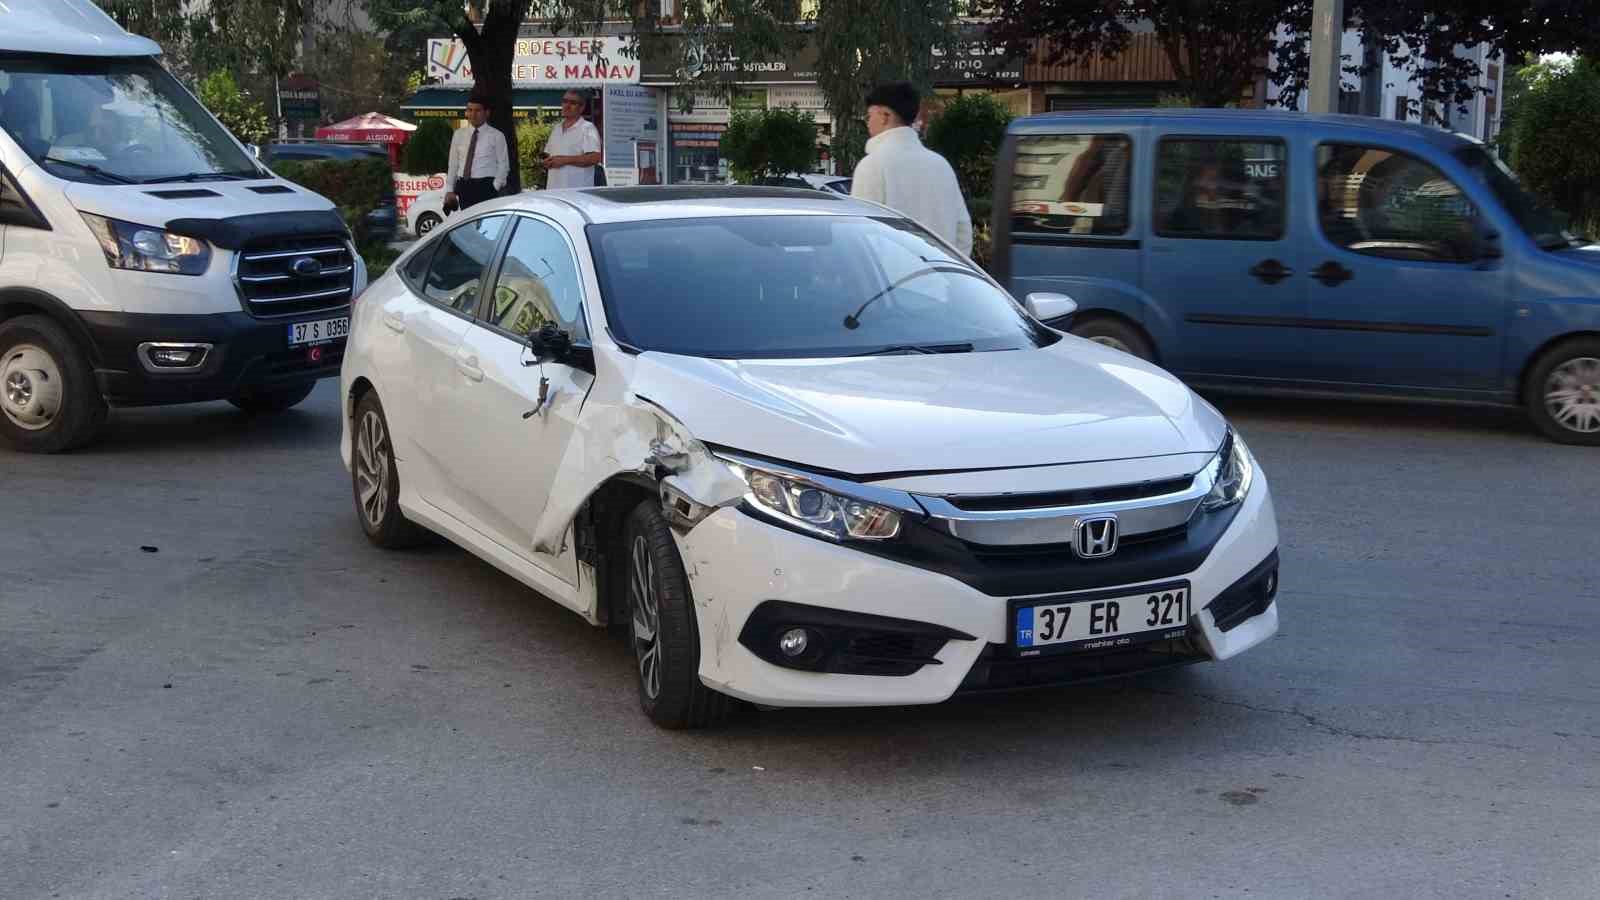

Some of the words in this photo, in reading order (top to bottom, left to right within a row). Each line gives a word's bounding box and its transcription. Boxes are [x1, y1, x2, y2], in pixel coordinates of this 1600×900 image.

[545, 65, 557, 78] &
[564, 65, 635, 79] MANAV
[296, 324, 308, 341] 37
[313, 322, 320, 338] S
[1039, 606, 1072, 641] 37
[1089, 601, 1120, 635] ER
[1146, 591, 1184, 627] 321
[1020, 630, 1033, 640] TR
